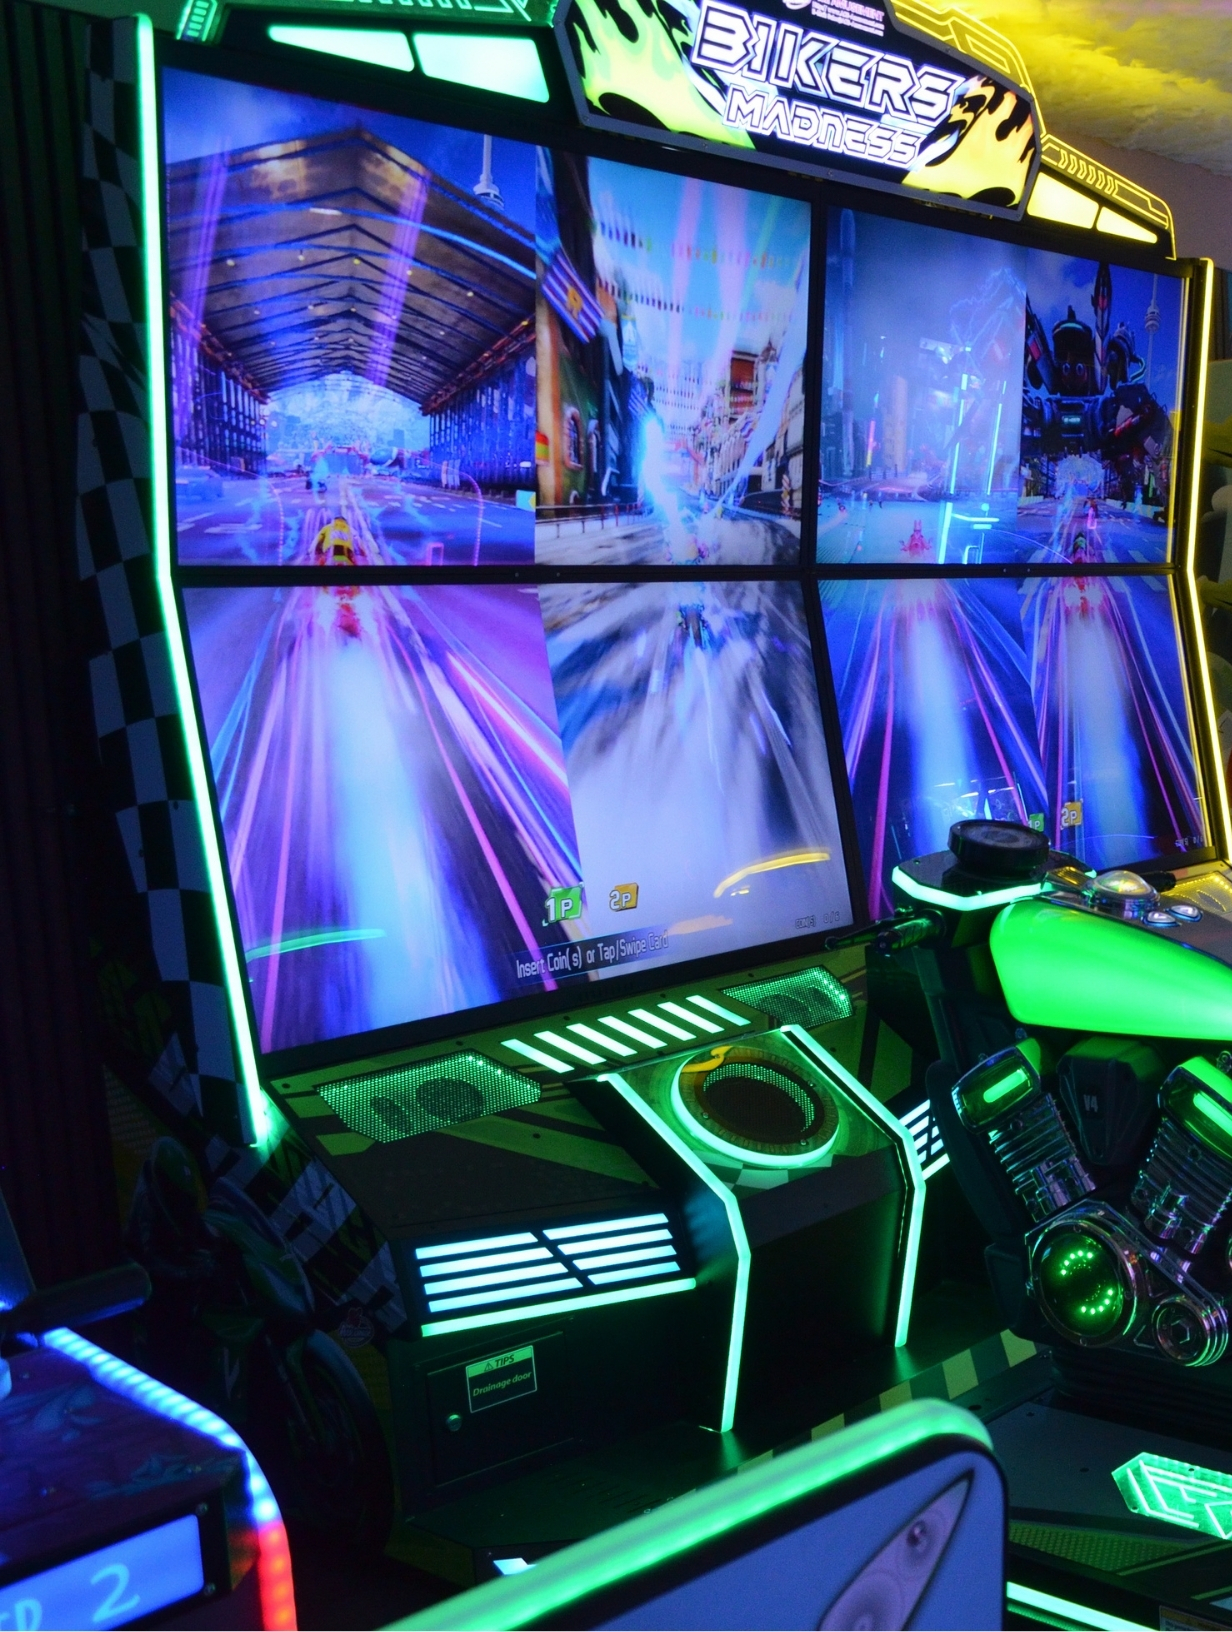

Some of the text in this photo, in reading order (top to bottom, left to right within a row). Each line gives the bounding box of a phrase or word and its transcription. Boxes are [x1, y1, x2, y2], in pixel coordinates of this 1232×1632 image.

[691, 1, 966, 127] BIKERS
[722, 82, 928, 172] MADNESS
[1061, 807, 1077, 827] 2P
[545, 897, 573, 922] 1P
[609, 890, 632, 912] 2P
[516, 930, 669, 979] Insert Coin(s) or Tap/Swipe Card
[495, 1354, 515, 1369] TIPS
[472, 1371, 532, 1397] Drainage door
[90, 1563, 141, 1623] 2
